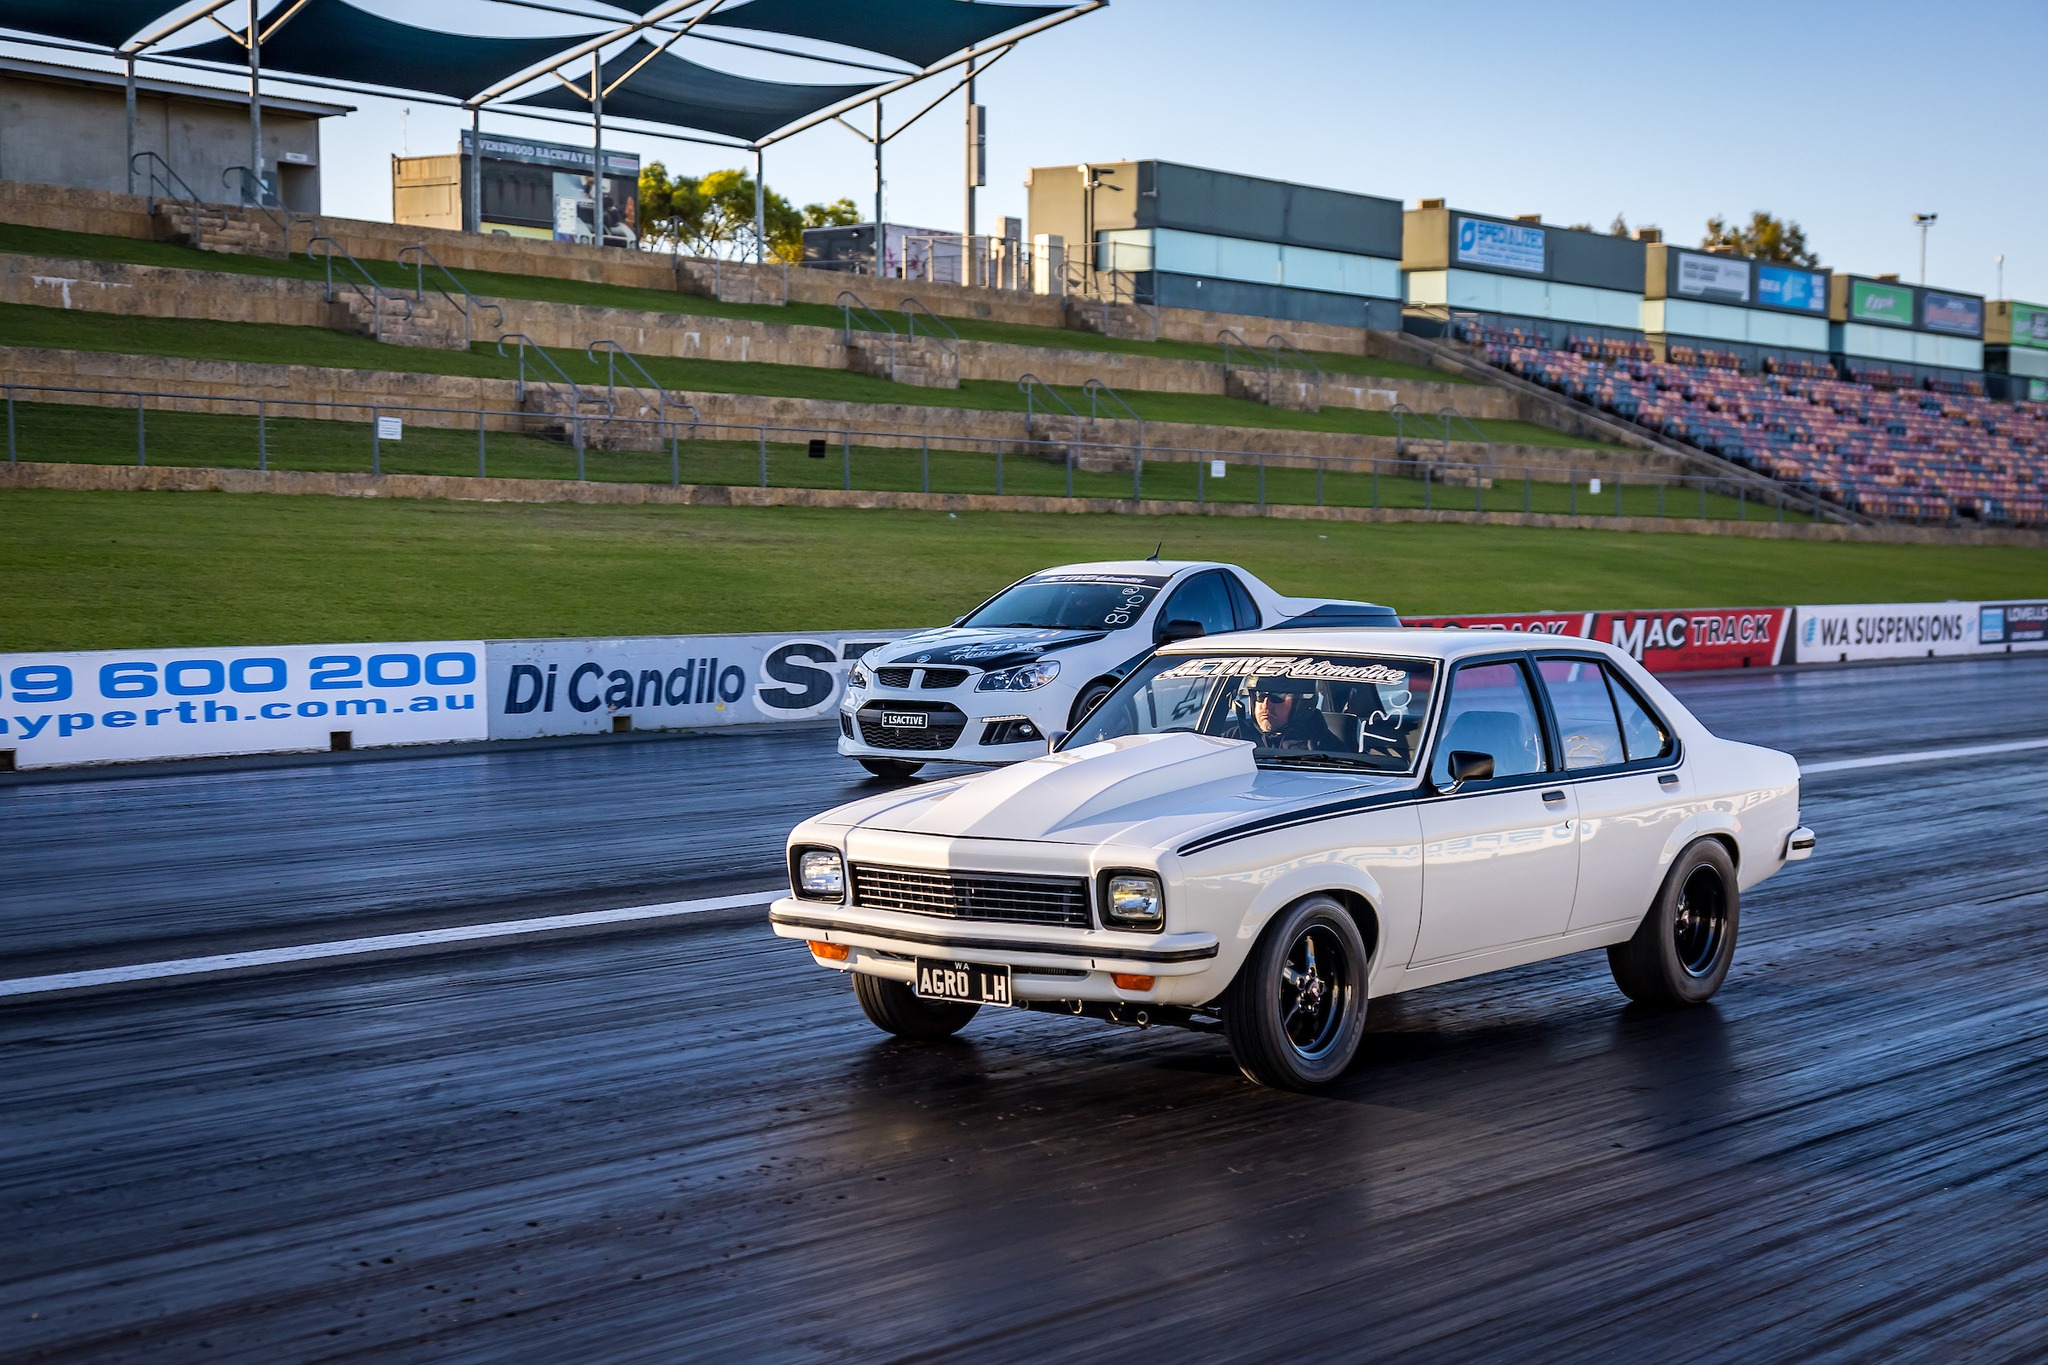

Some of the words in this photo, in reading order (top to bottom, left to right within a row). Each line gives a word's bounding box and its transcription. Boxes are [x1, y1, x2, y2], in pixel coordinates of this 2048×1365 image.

[464, 137, 534, 156] RVENSWOOD
[536, 147, 584, 163] RACEWAY
[1611, 616, 1689, 661] MAC
[1690, 614, 1772, 647] TRACK
[1822, 617, 1850, 645] WA
[1855, 614, 1963, 645] SUSPENSIONS
[0, 665, 73, 703] 9
[99, 657, 288, 699] 600
[309, 652, 477, 690] 200
[504, 664, 558, 714] Di
[568, 657, 746, 713] Candilo
[1154, 656, 1298, 681] ACTIVE
[1281, 658, 1406, 685] Automotive
[0, 694, 474, 740] yperth.com.au
[888, 715, 924, 725] LSACTIVE
[954, 962, 970, 970] WA
[920, 967, 969, 997] AGRO
[981, 973, 1006, 1001] LH
